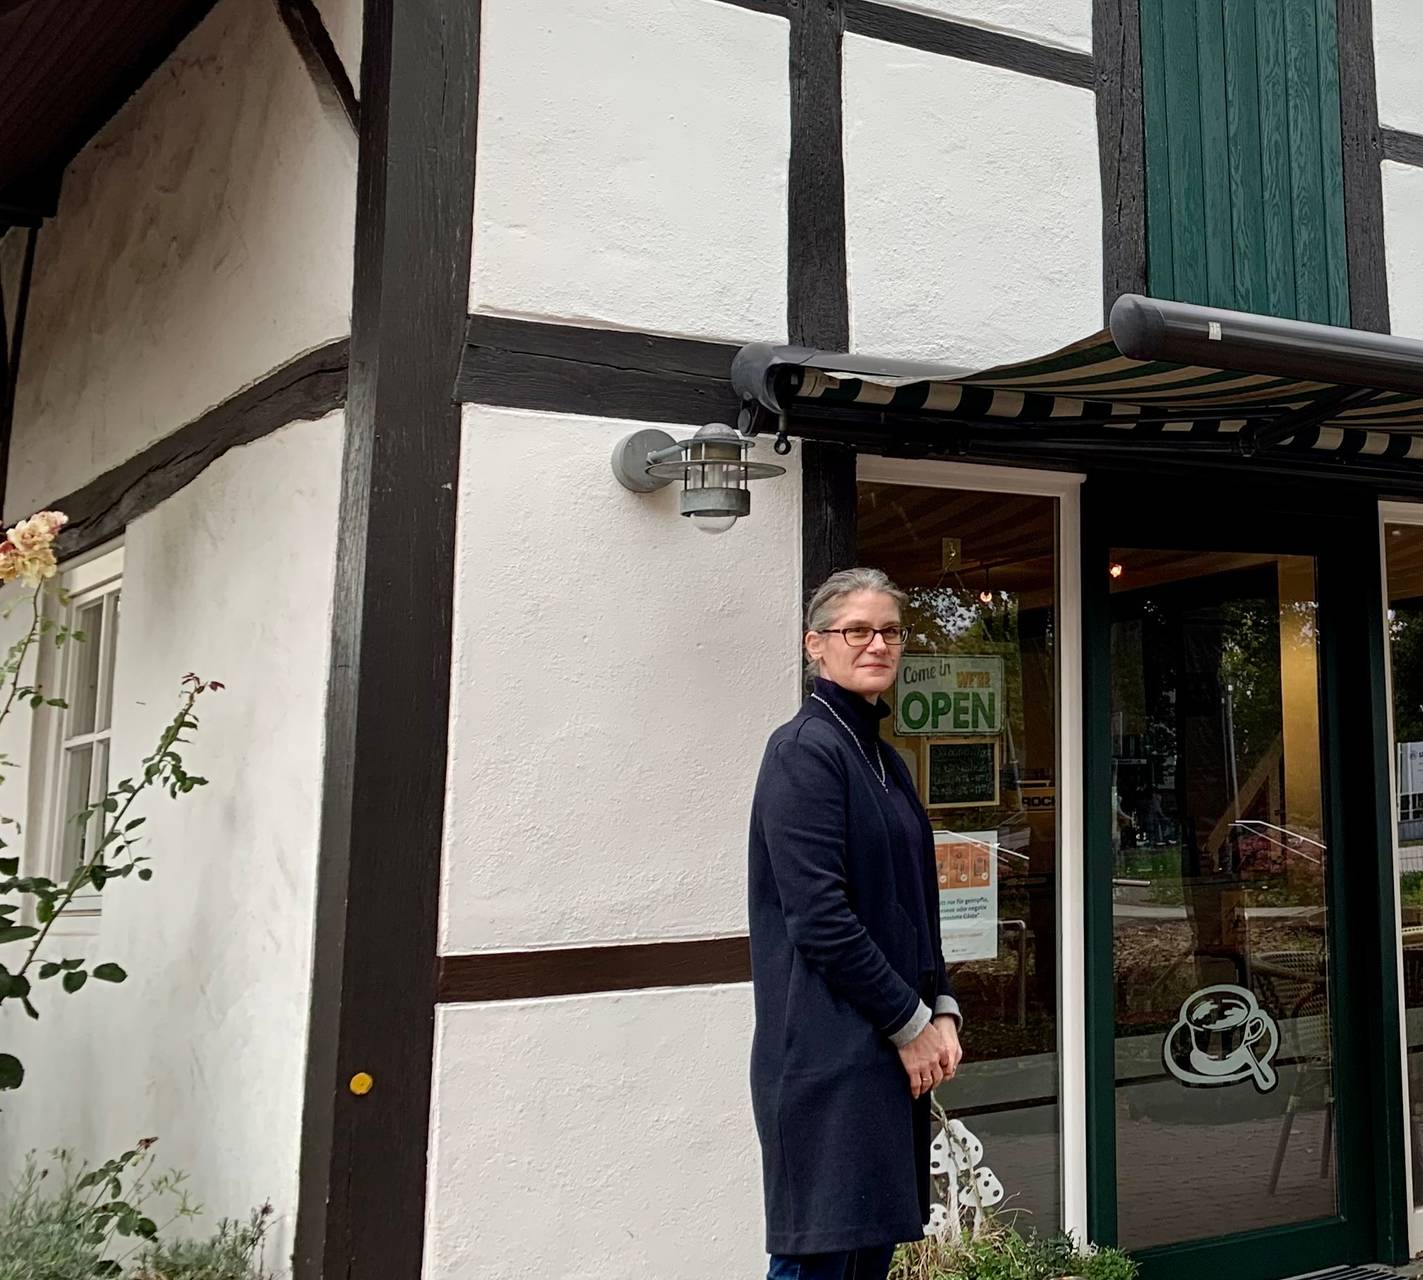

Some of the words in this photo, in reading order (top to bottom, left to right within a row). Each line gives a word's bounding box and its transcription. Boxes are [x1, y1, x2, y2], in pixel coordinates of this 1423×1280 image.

[903, 666, 936, 684] Come
[939, 660, 951, 677] in
[956, 671, 991, 688] WE'RE
[901, 691, 995, 729] OPEN
